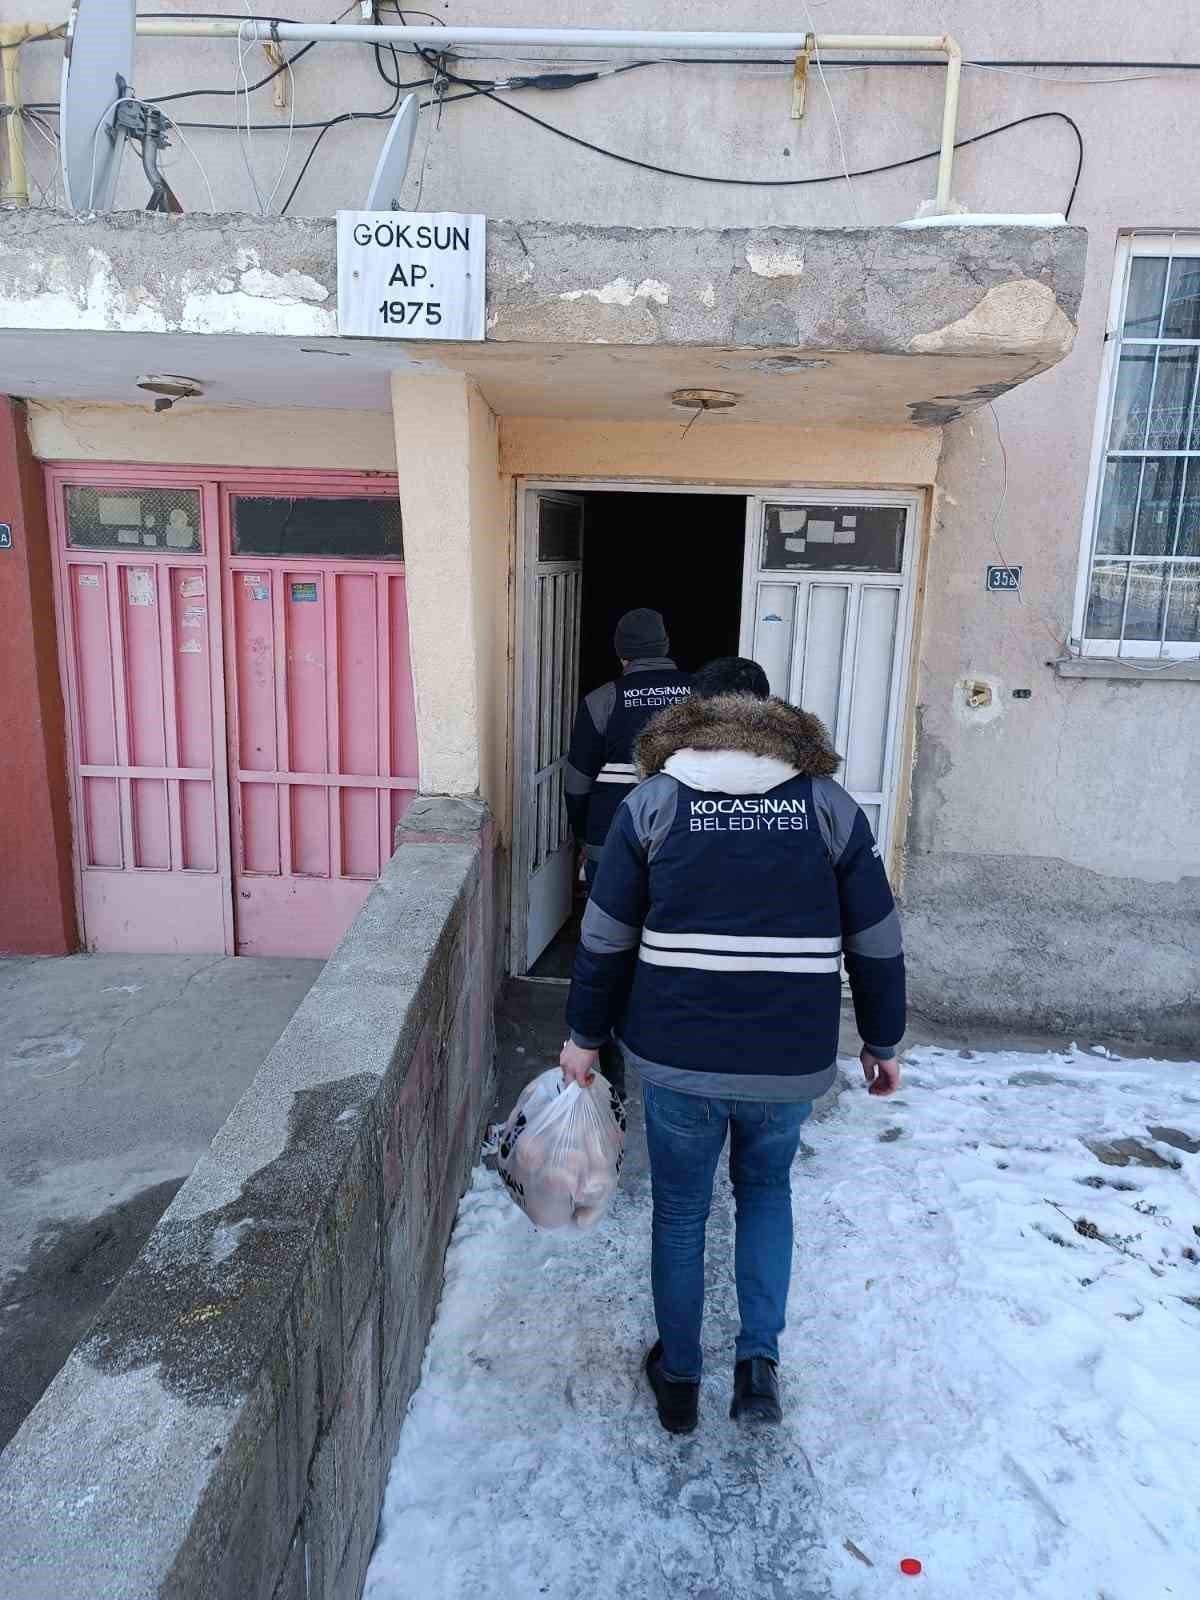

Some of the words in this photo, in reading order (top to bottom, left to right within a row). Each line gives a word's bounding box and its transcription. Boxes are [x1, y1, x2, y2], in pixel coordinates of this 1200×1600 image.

[353, 220, 470, 251] GÖKSUN
[388, 263, 434, 288] AP.
[379, 300, 442, 325] 1975
[690, 815, 809, 832] BELEDİYESİ
